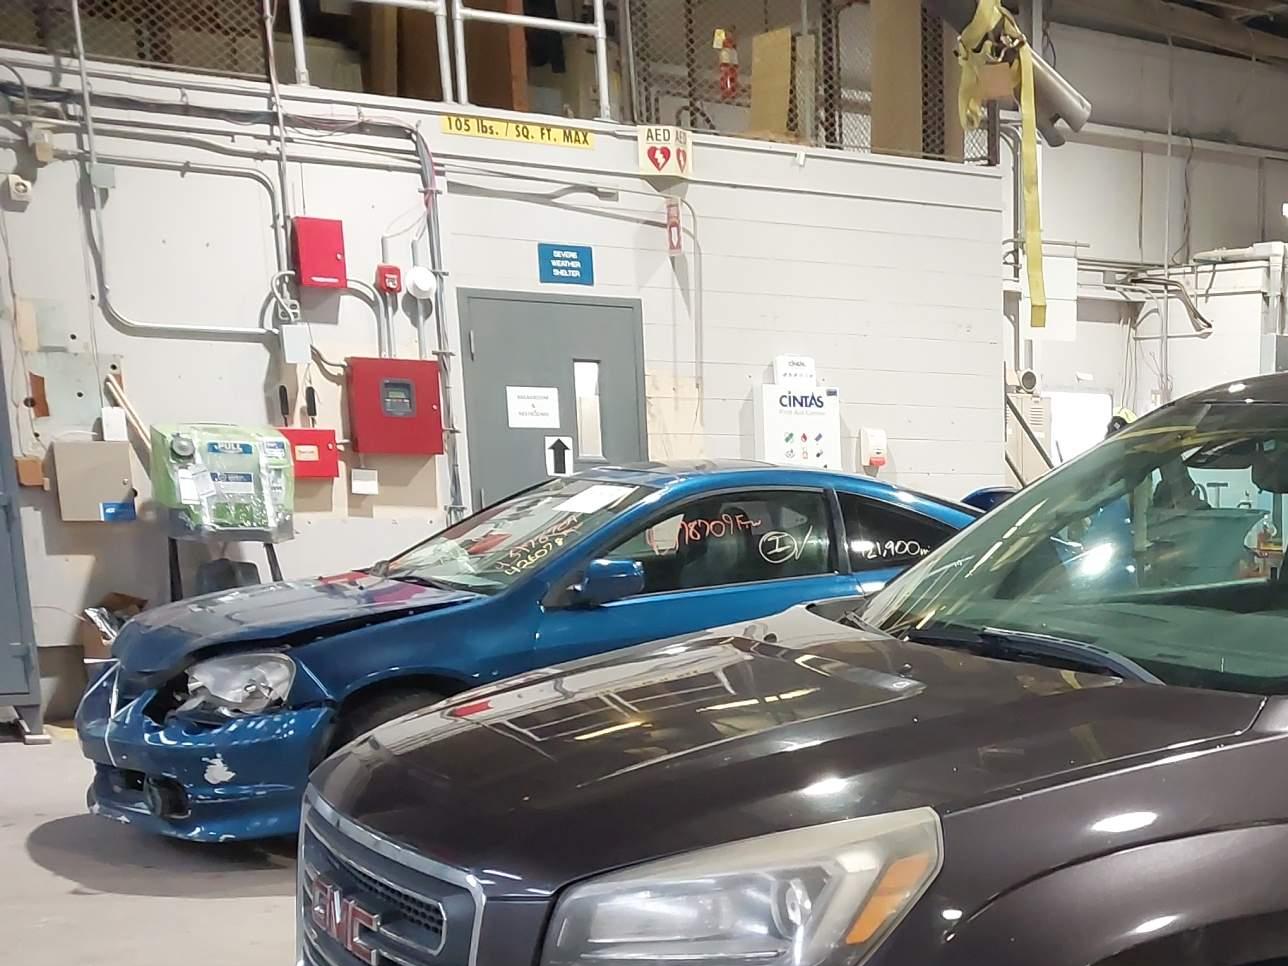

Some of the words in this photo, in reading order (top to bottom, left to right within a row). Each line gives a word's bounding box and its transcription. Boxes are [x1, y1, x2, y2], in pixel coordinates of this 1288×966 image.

[447, 117, 471, 132] 105
[476, 119, 499, 136] lbs.
[515, 124, 535, 140] SQ.
[541, 127, 557, 142] FT.
[562, 130, 590, 145] MAX
[646, 128, 671, 142] AED
[550, 259, 581, 268] WEATHER
[553, 268, 581, 278] SHELTER
[312, 877, 380, 966] GMC
